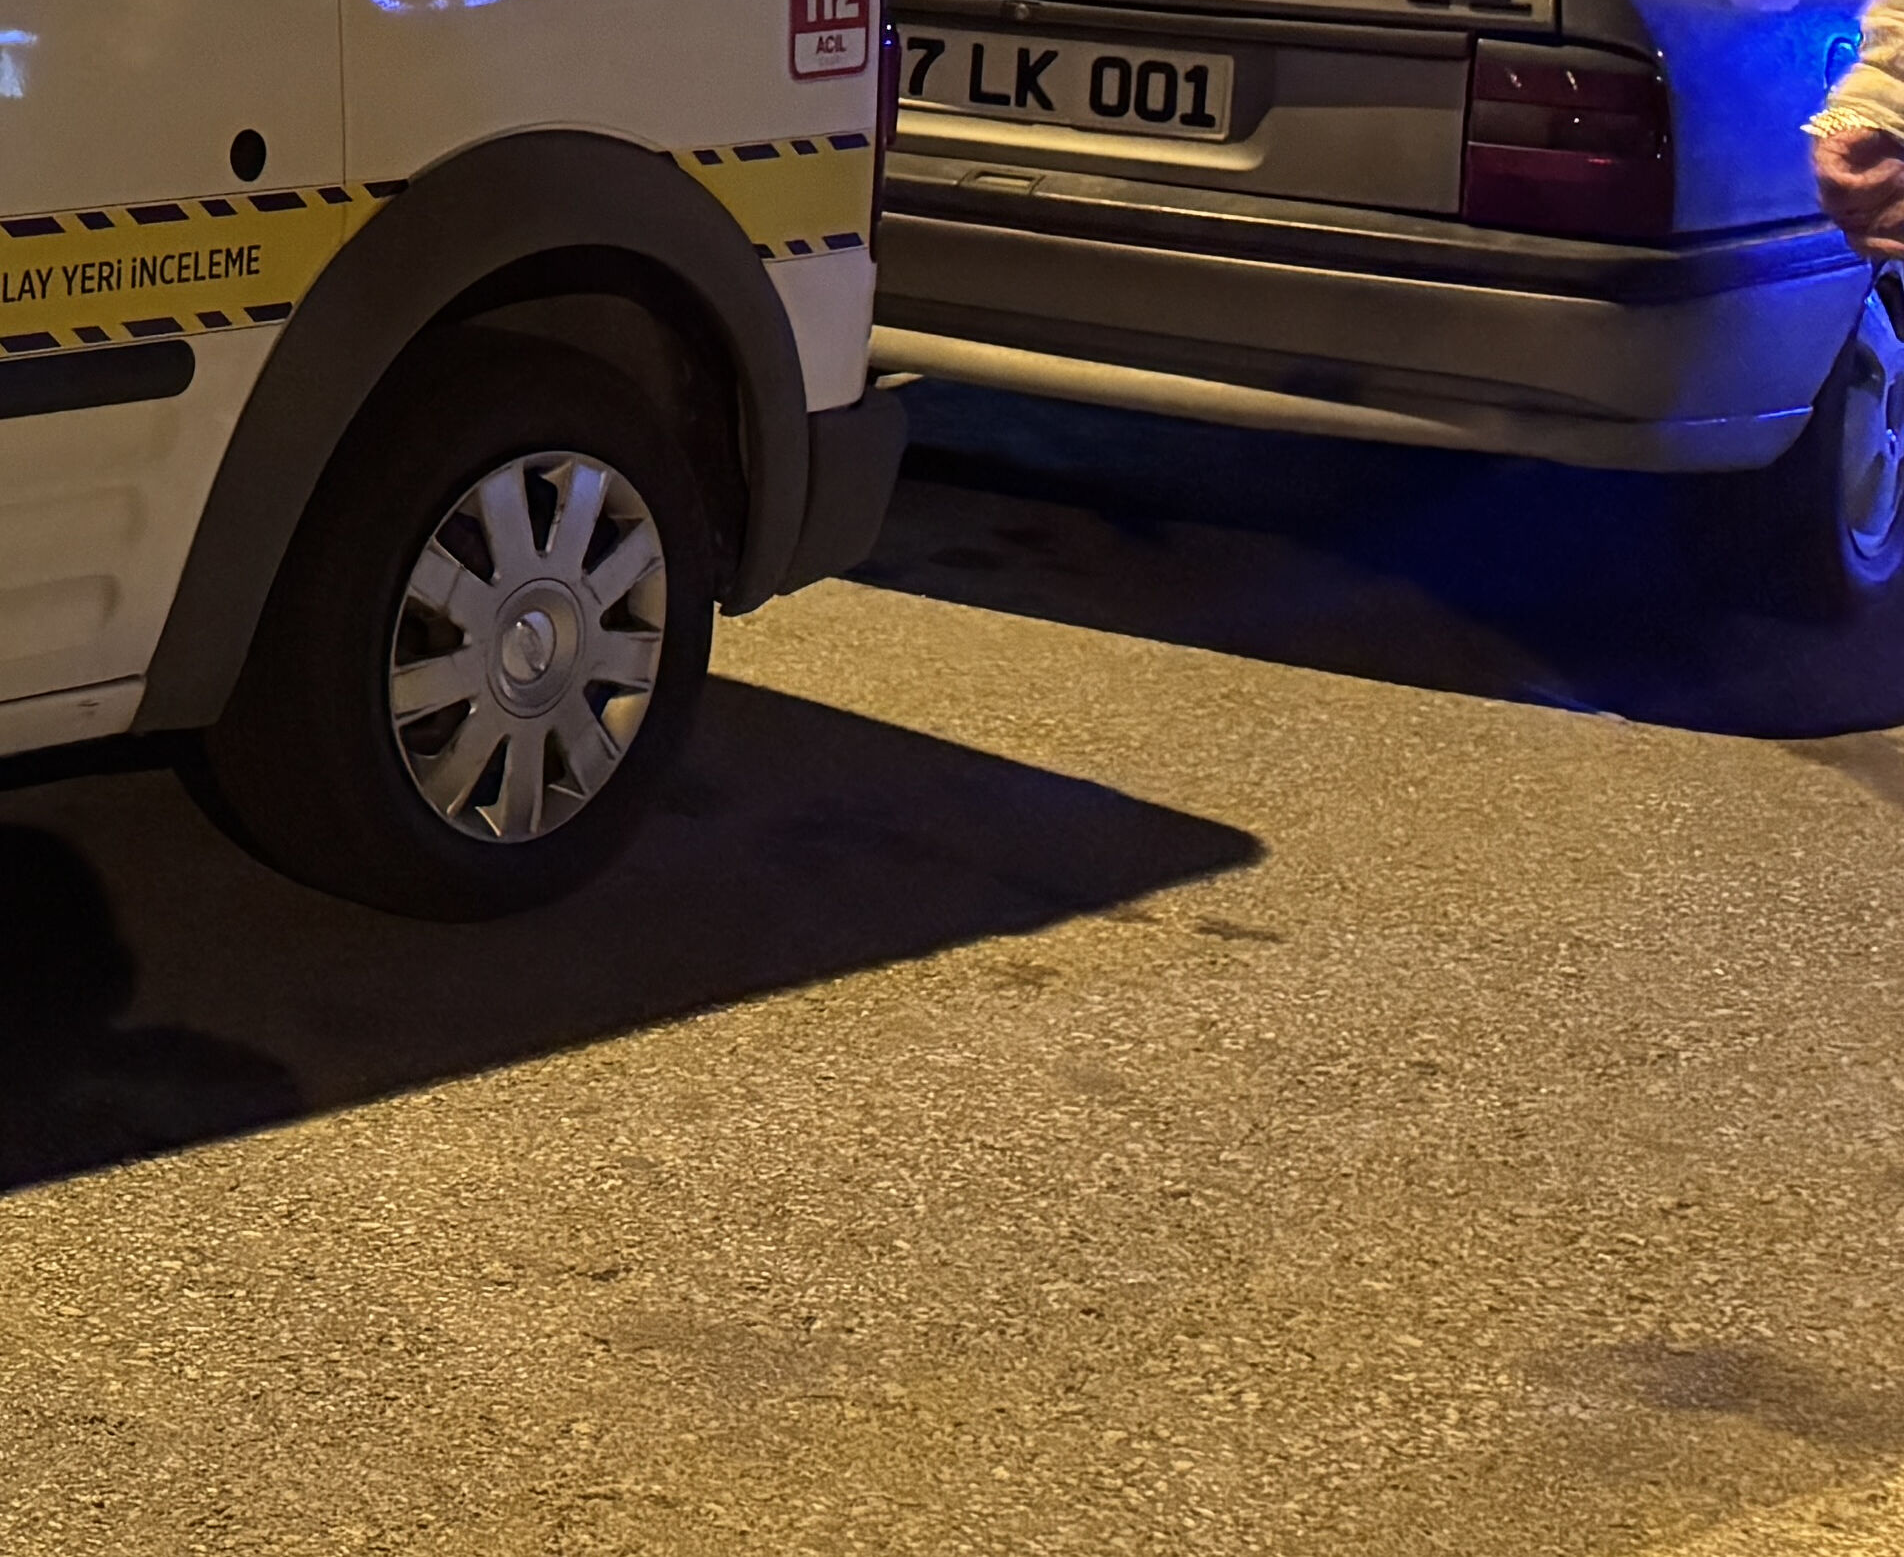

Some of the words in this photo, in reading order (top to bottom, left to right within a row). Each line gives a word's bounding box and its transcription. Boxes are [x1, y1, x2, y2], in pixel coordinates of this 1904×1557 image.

[968, 42, 1060, 112] LK
[1088, 55, 1216, 129] 001
[61, 258, 123, 296] YERİ
[129, 244, 262, 289] İNCELEME
